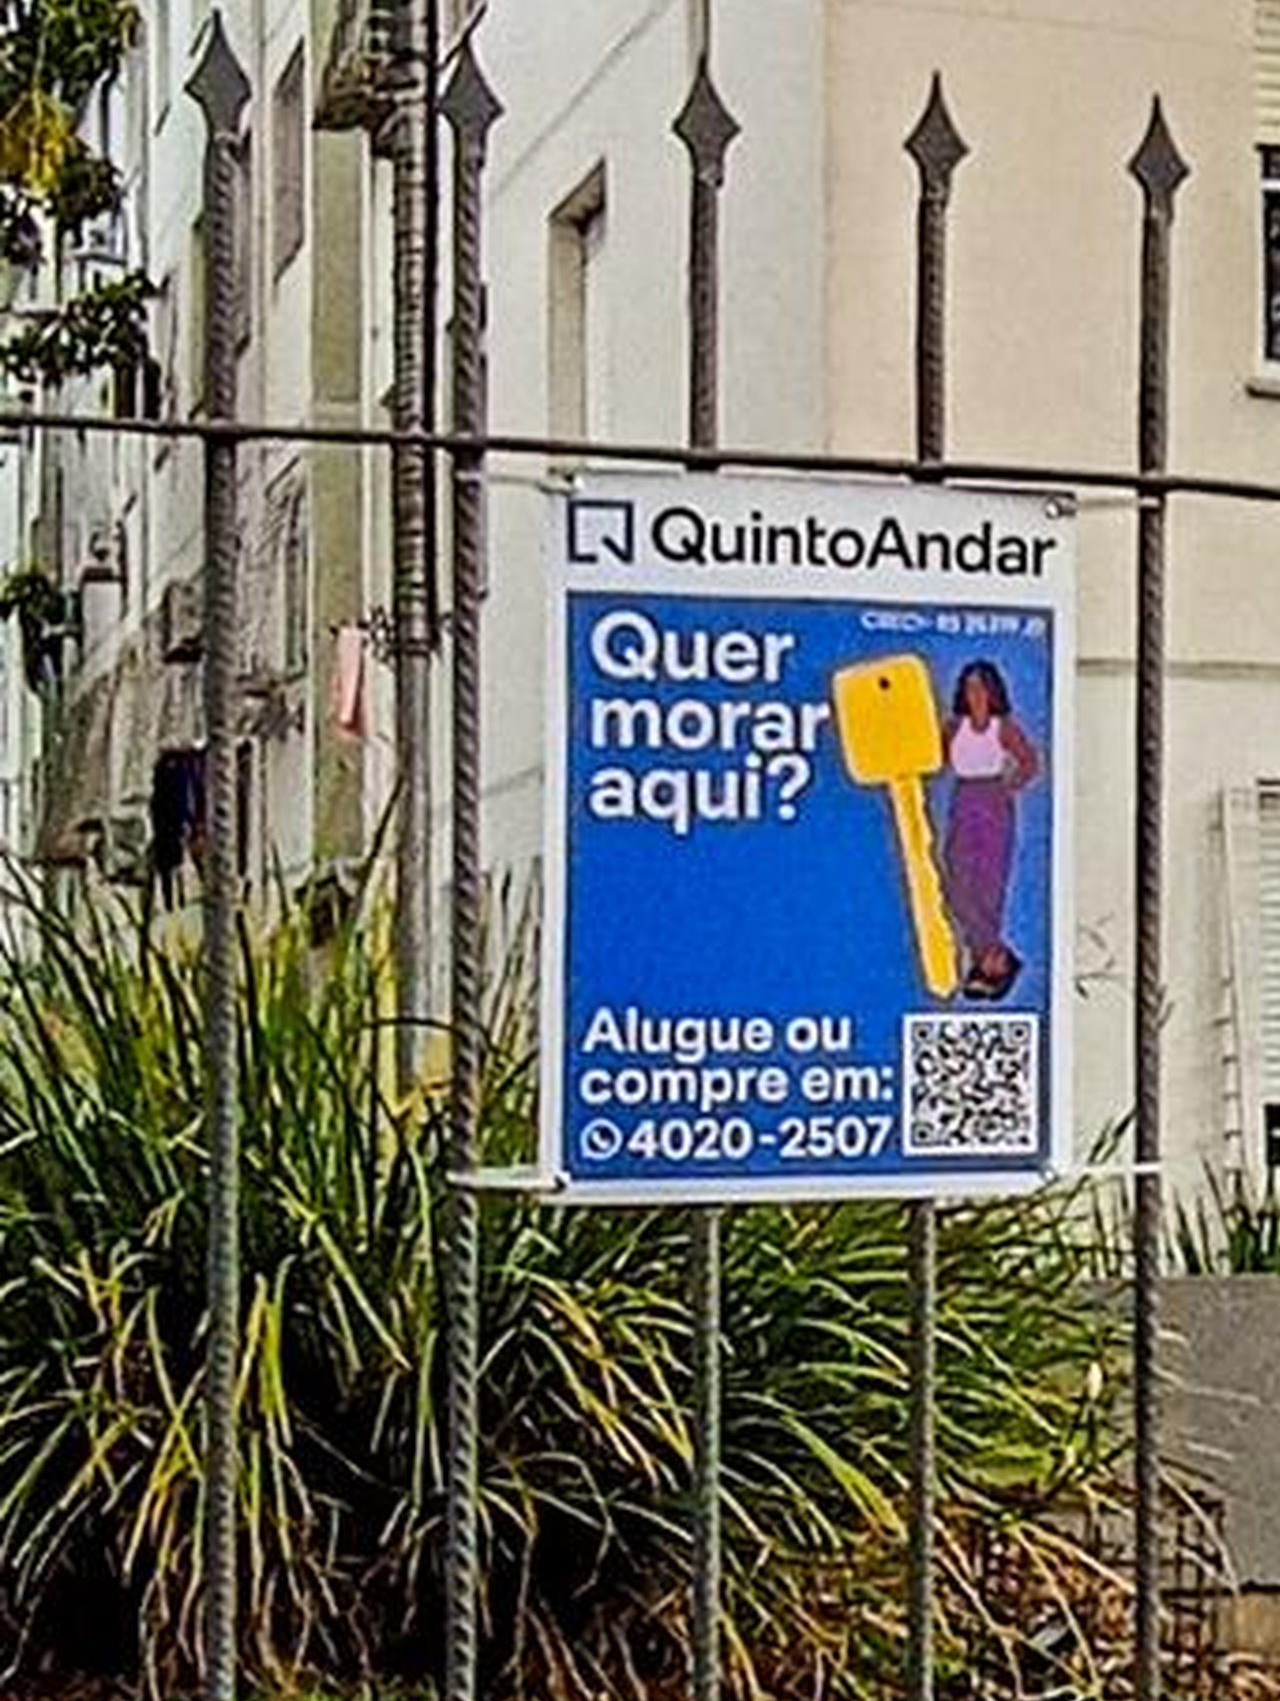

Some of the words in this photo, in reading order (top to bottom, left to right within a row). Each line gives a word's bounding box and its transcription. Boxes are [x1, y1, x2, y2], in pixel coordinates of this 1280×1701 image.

[651, 506, 1057, 577] QuintoAndar
[590, 610, 795, 683] Quer
[591, 696, 830, 751] morar
[589, 753, 810, 835] aqui?
[581, 1006, 774, 1063] Alugue
[786, 1016, 851, 1052] ou
[579, 1067, 789, 1113] compre
[801, 1065, 895, 1102] em:
[627, 1115, 893, 1159] 4020-2507
